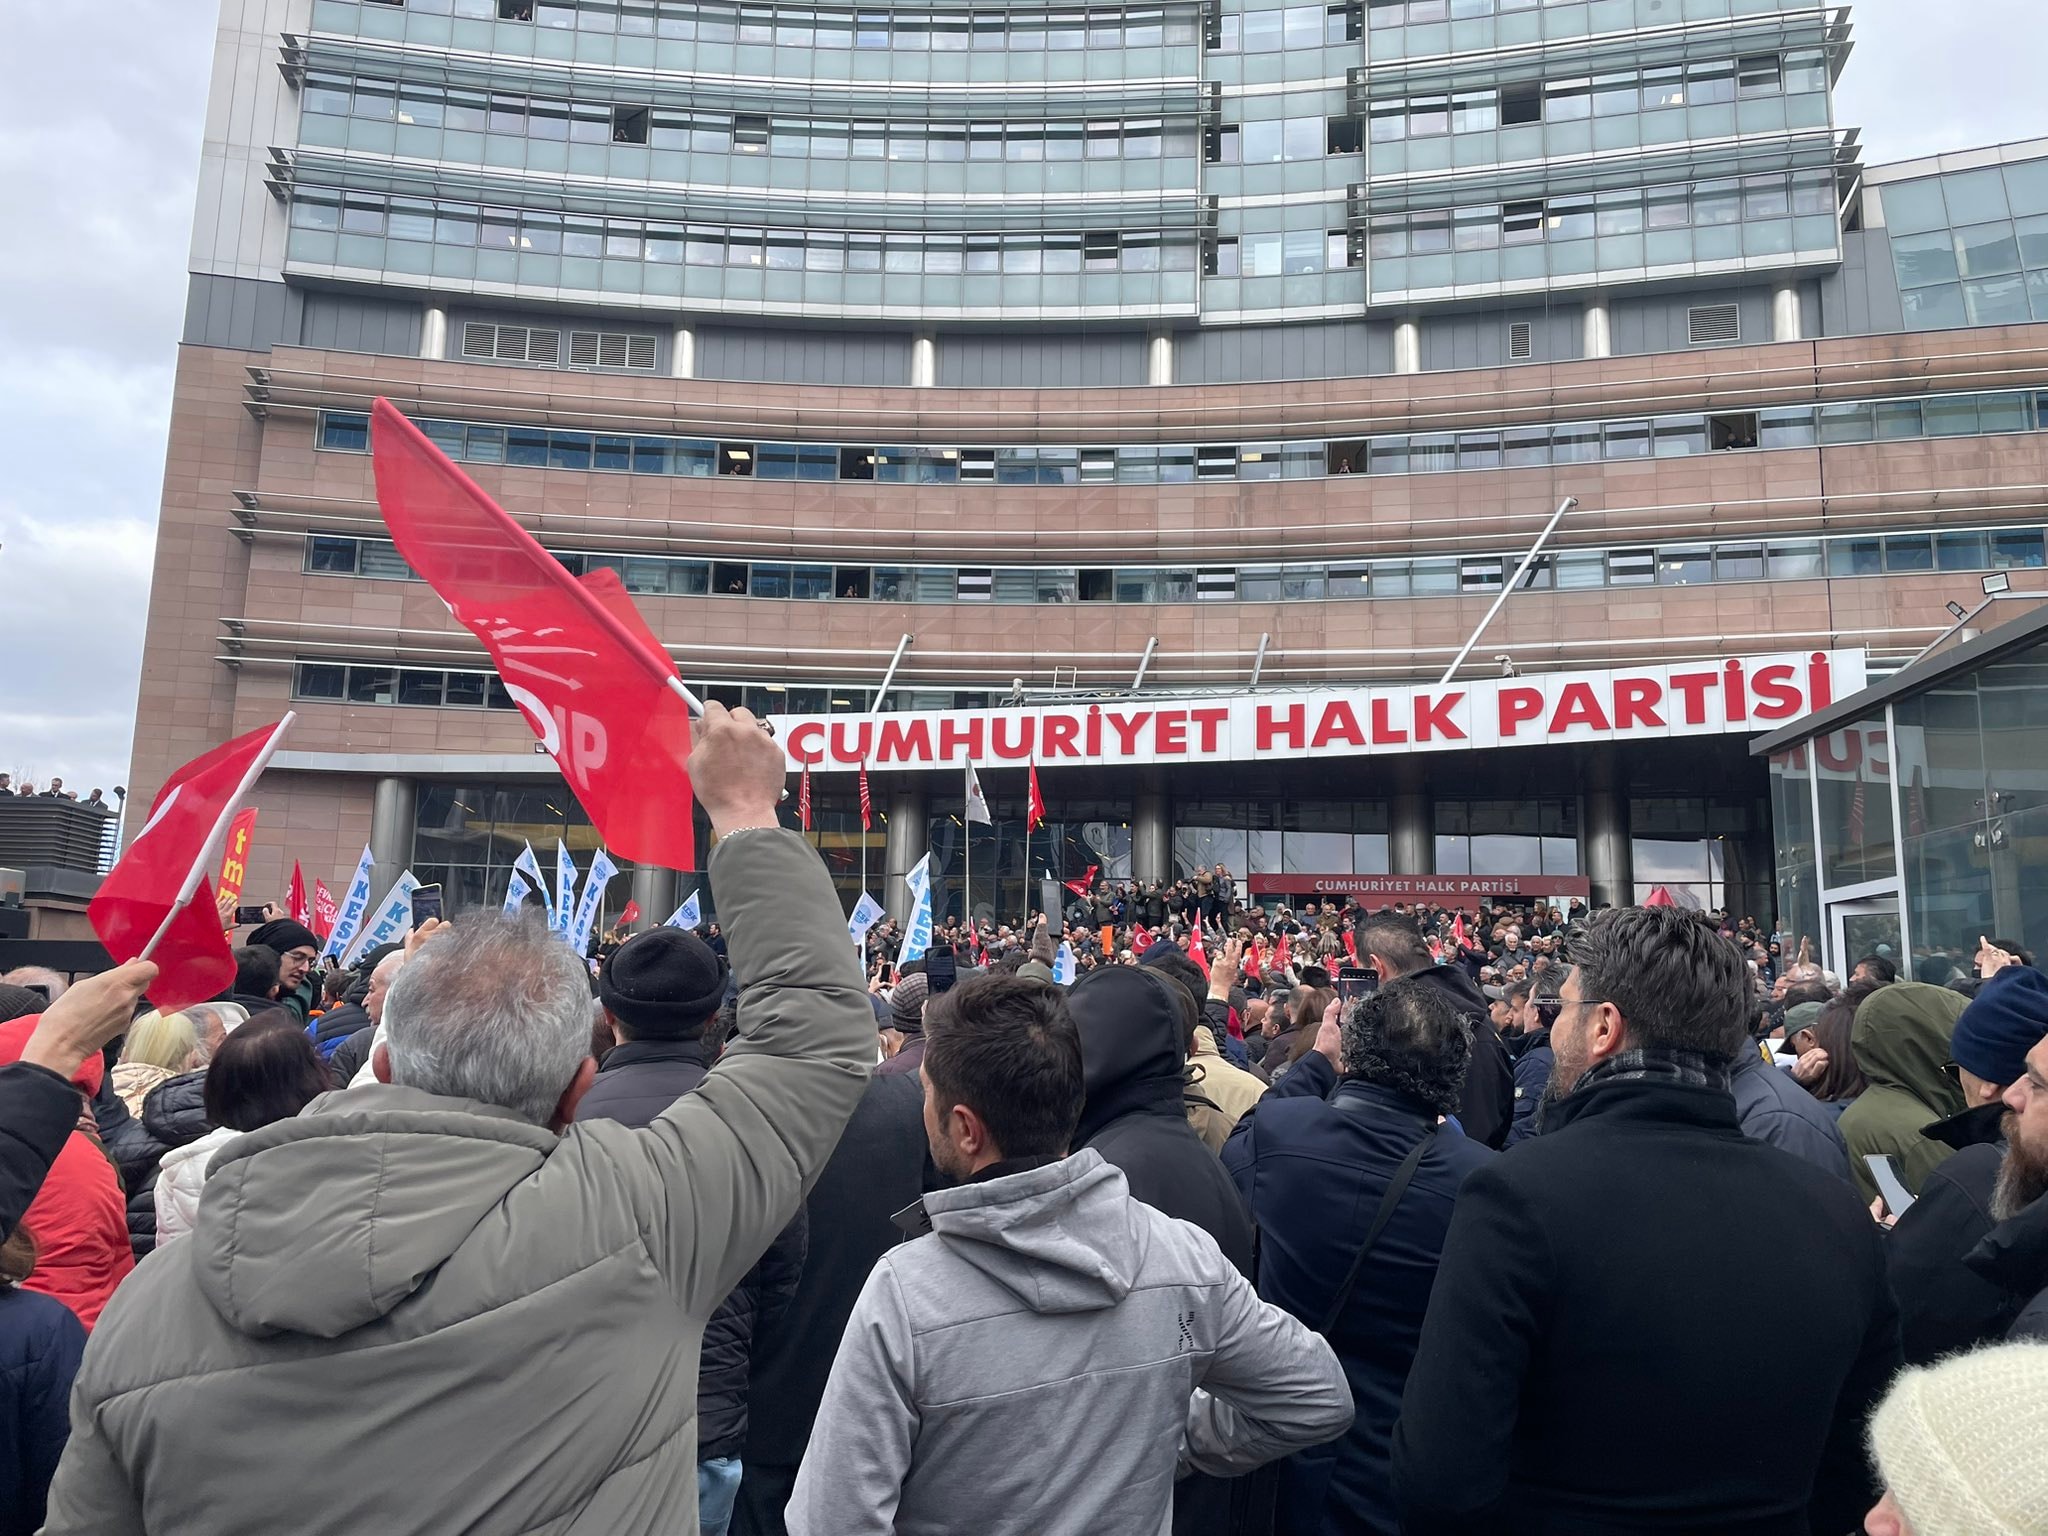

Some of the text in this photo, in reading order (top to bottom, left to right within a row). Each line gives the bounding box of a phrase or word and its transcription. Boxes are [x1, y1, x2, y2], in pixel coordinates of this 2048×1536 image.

[787, 651, 1832, 764] CUMHURİYET HALK PARTİSİ
[1315, 877, 1519, 893] CUMHURİYET HALK PARTİSİ
